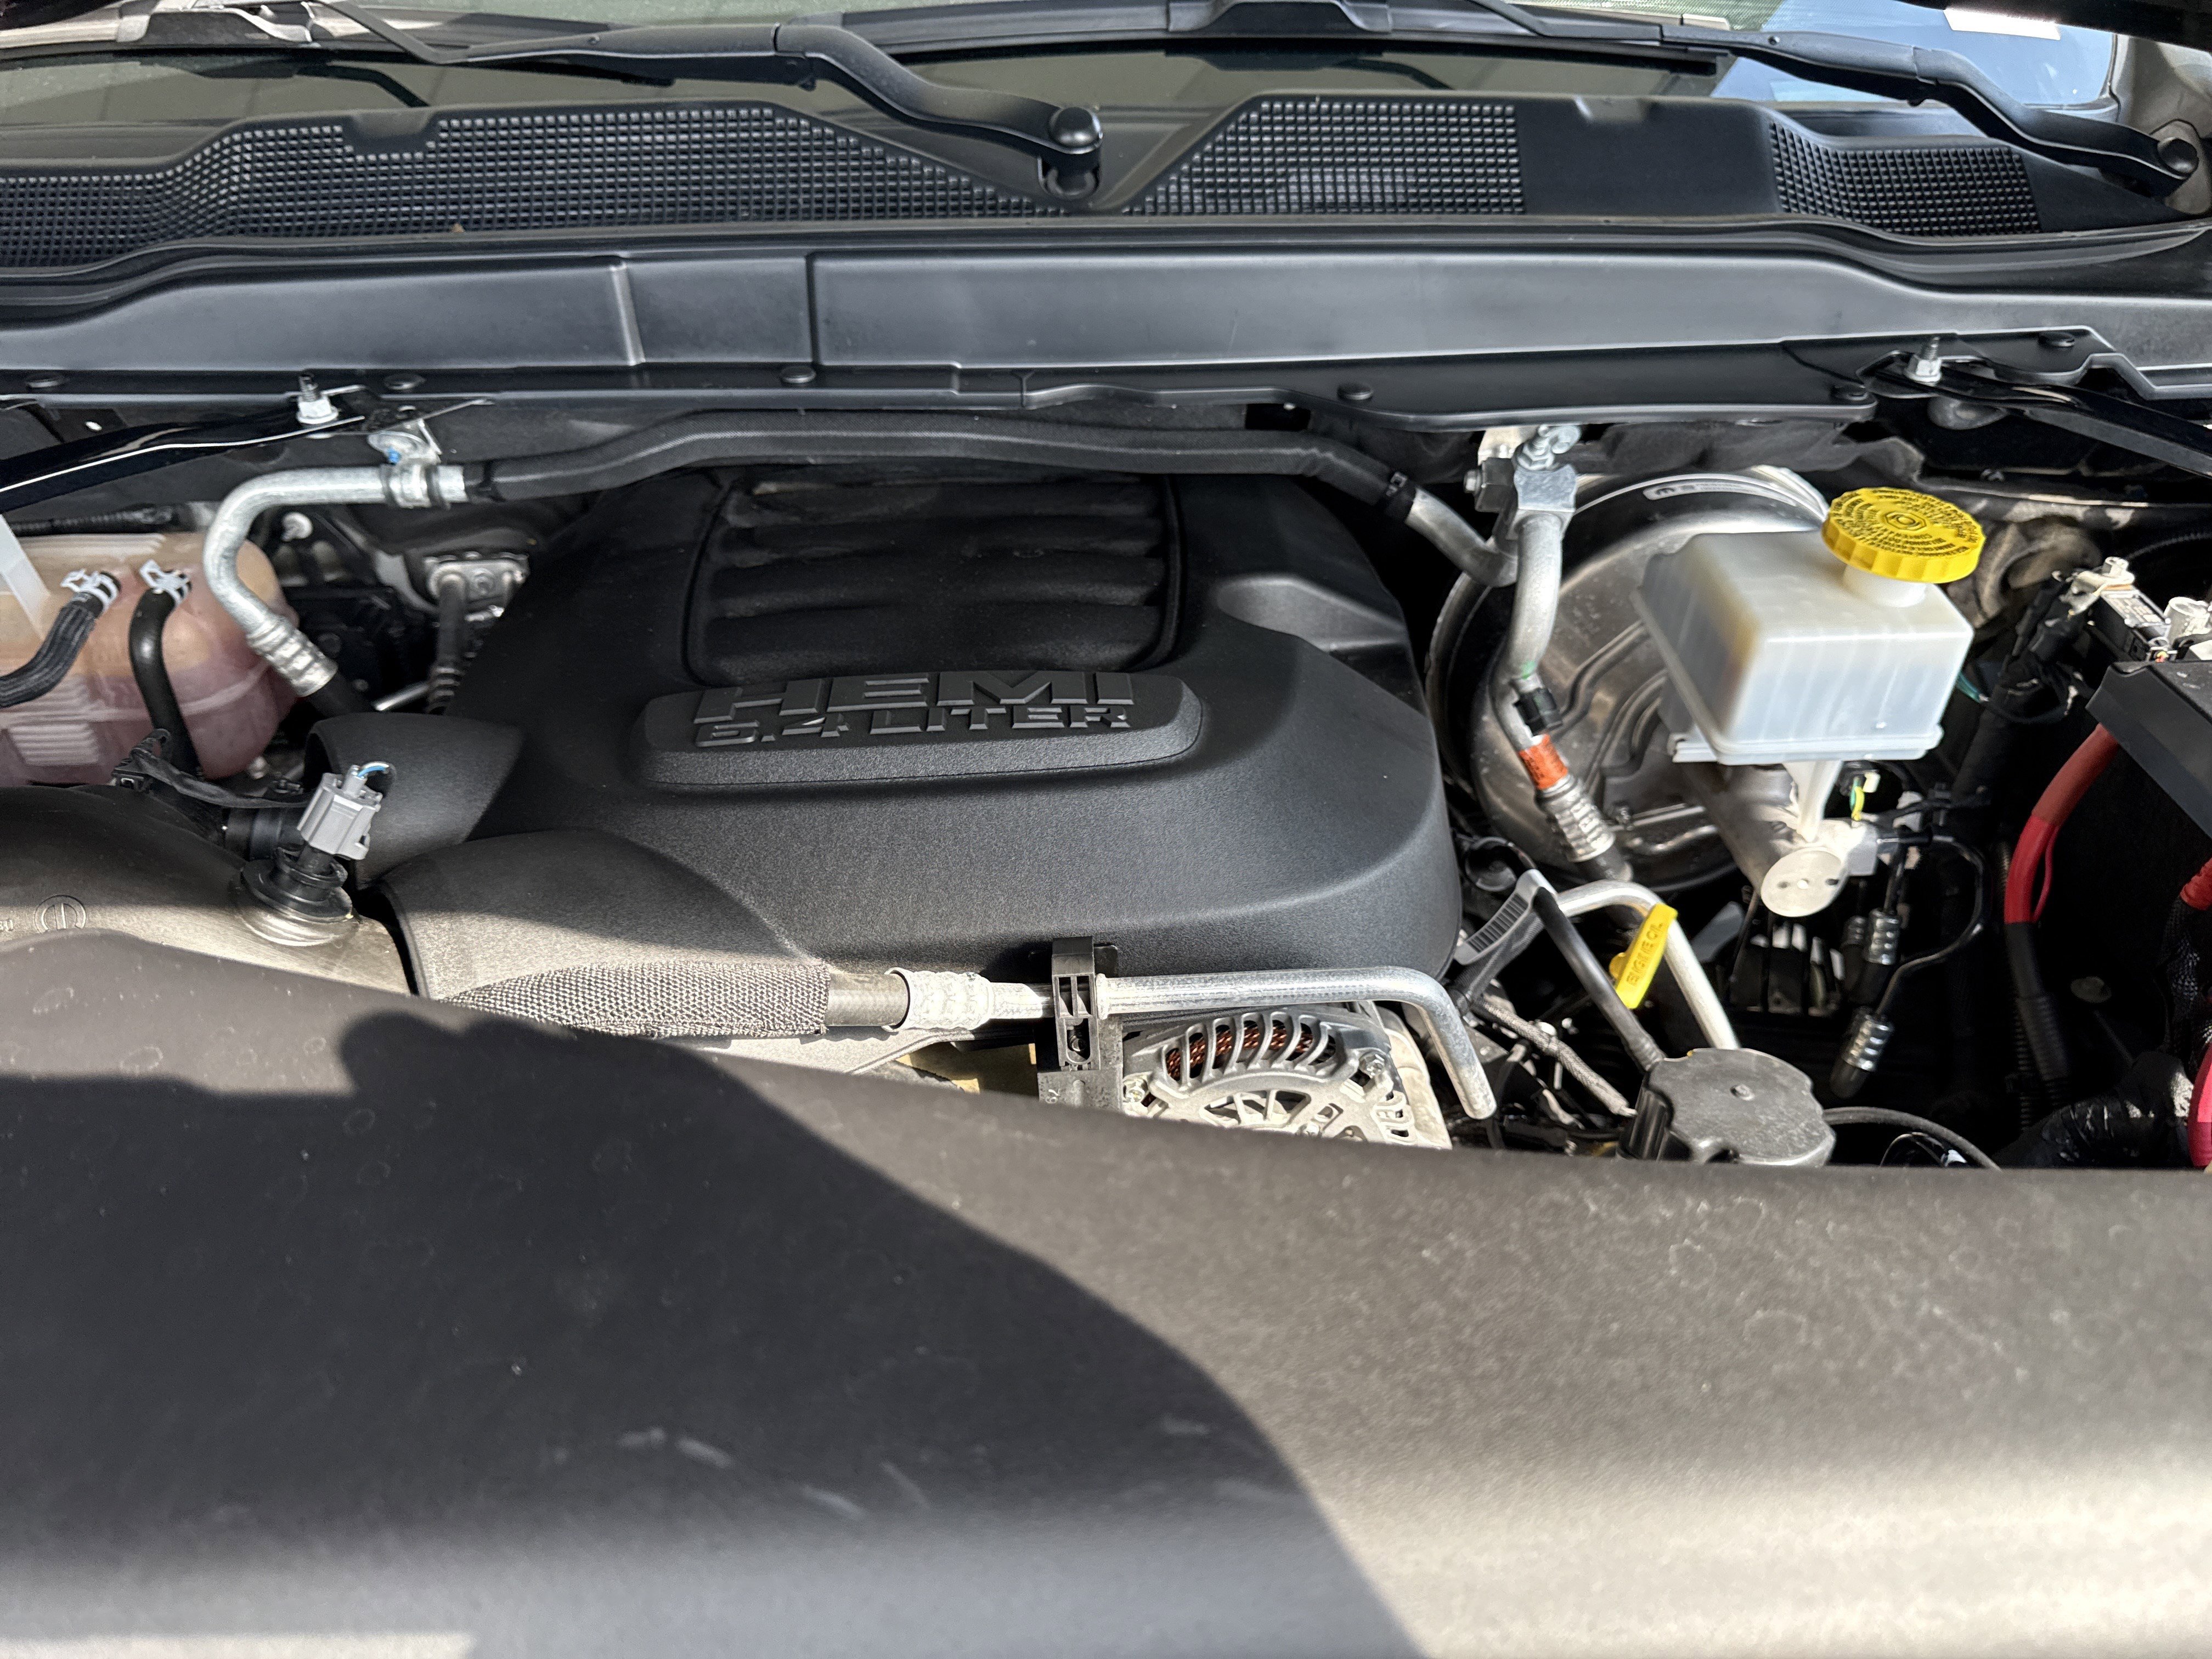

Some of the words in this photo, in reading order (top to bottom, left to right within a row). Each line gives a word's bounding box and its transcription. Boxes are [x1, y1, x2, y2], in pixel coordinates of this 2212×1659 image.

[693, 671, 1134, 724] HEMI
[696, 712, 849, 747] 6.4
[870, 705, 1131, 735] LITER
